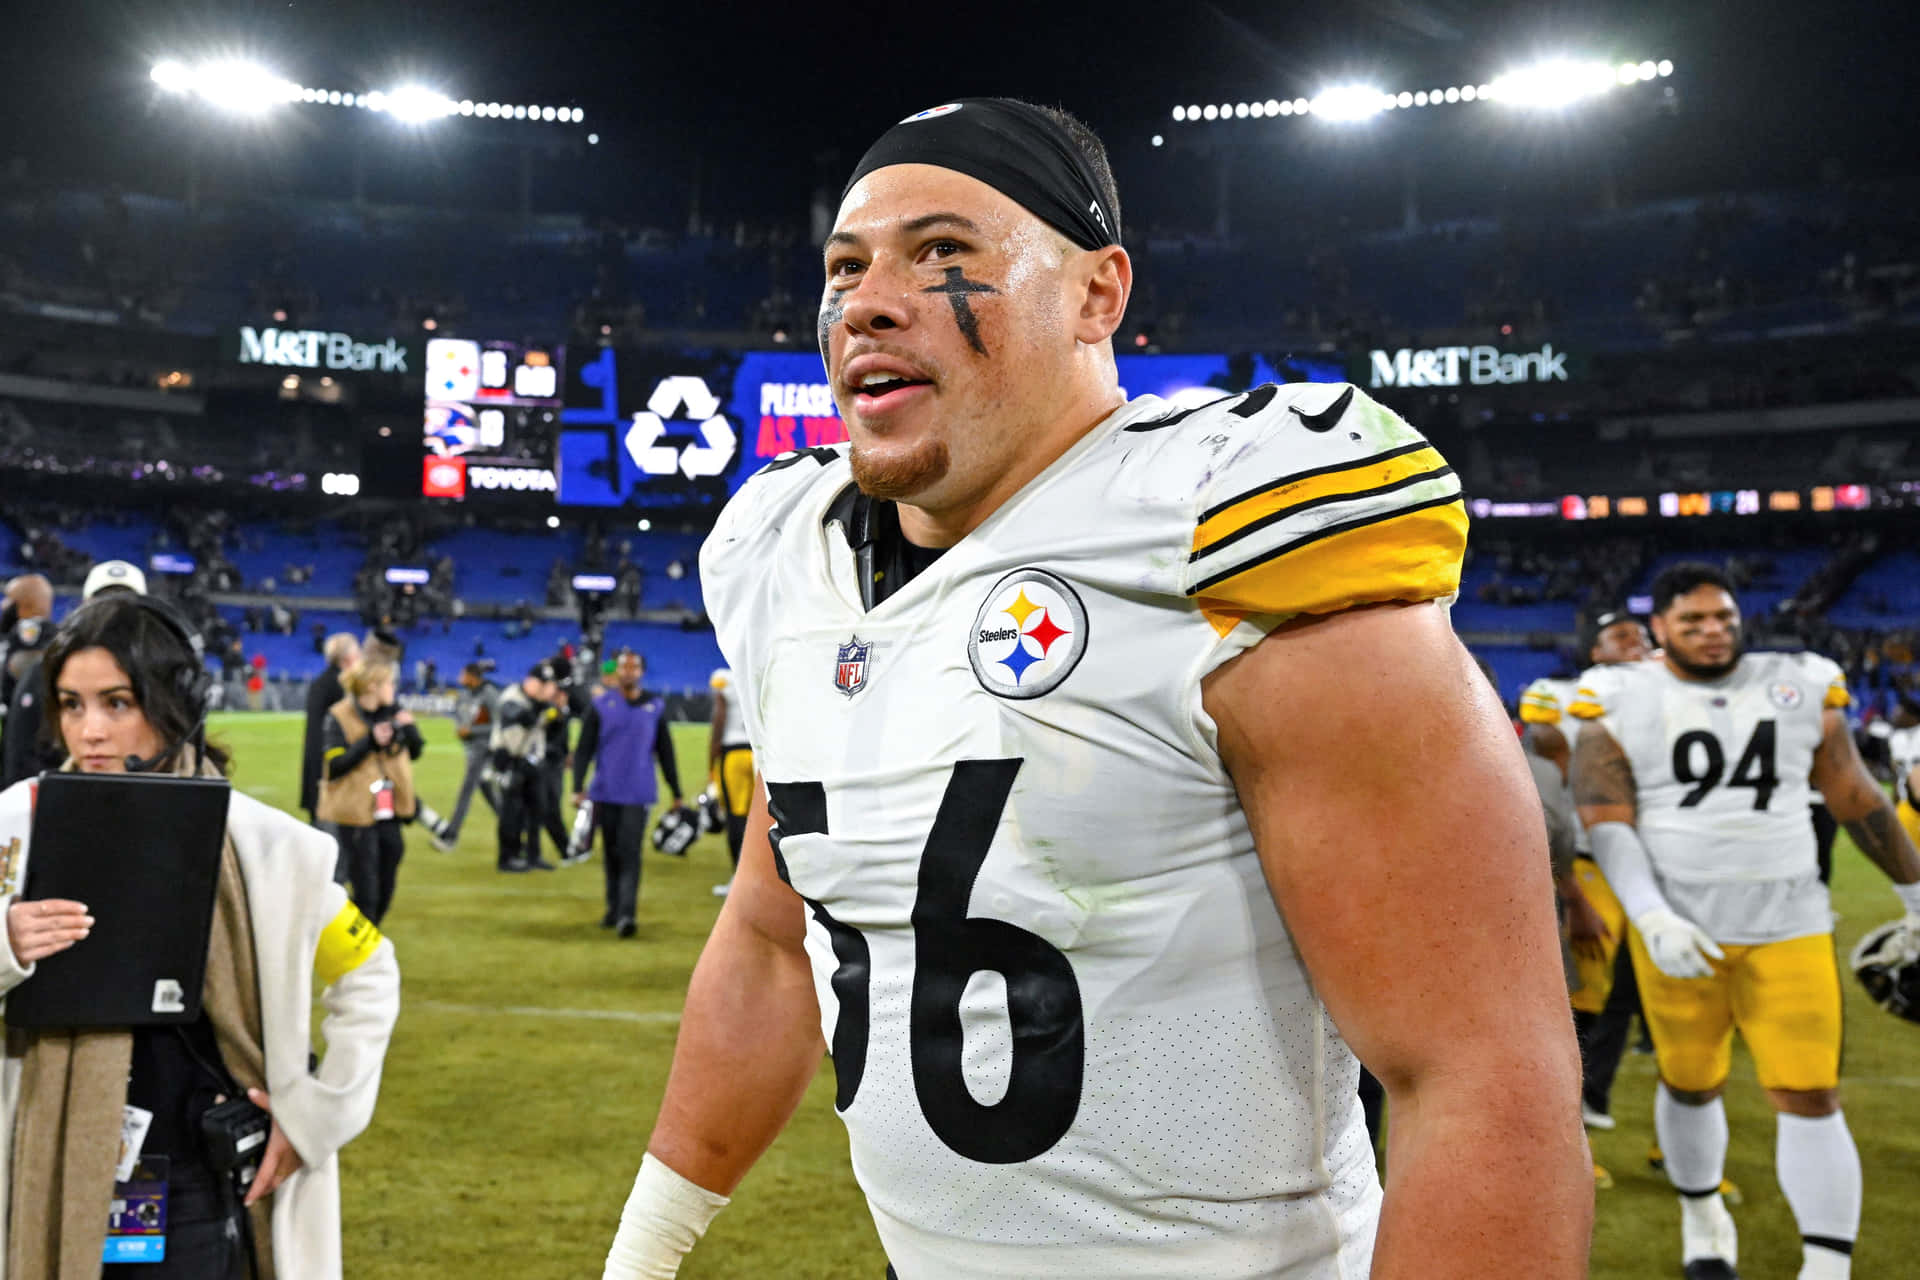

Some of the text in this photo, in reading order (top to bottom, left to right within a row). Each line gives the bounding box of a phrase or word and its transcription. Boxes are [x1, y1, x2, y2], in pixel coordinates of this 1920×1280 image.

[240, 326, 408, 373] M&T Bank
[1370, 343, 1568, 388] M&T Bank
[468, 467, 557, 491] TOYOTA
[979, 627, 1018, 644] Steelers
[838, 663, 862, 689] NFL
[1673, 719, 1780, 811] 94
